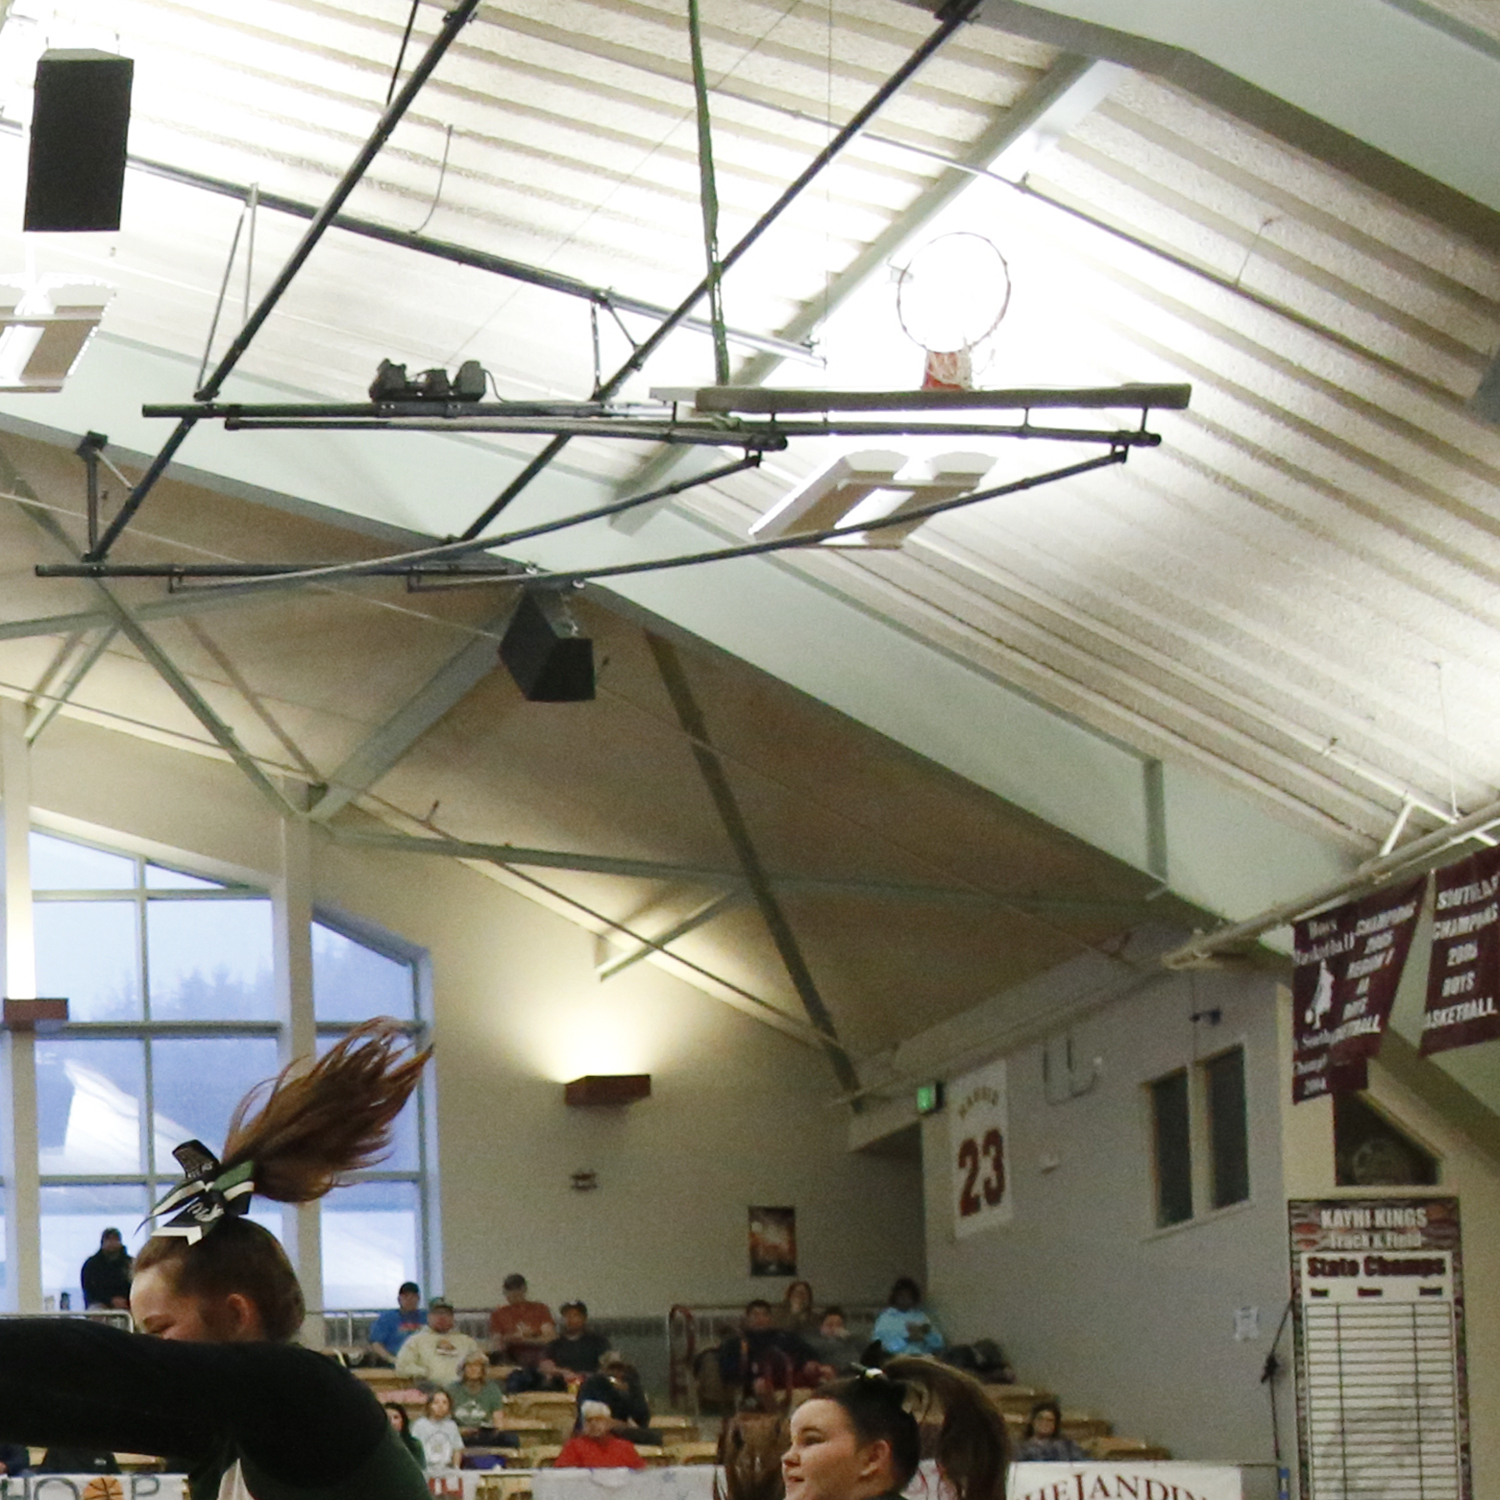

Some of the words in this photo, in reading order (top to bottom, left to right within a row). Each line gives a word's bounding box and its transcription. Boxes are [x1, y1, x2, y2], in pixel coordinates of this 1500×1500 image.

[958, 1128, 1005, 1217] 23
[1374, 1207, 1428, 1229] KINGS
[1307, 1256, 1360, 1278] State
[1364, 1255, 1446, 1278] Champs
